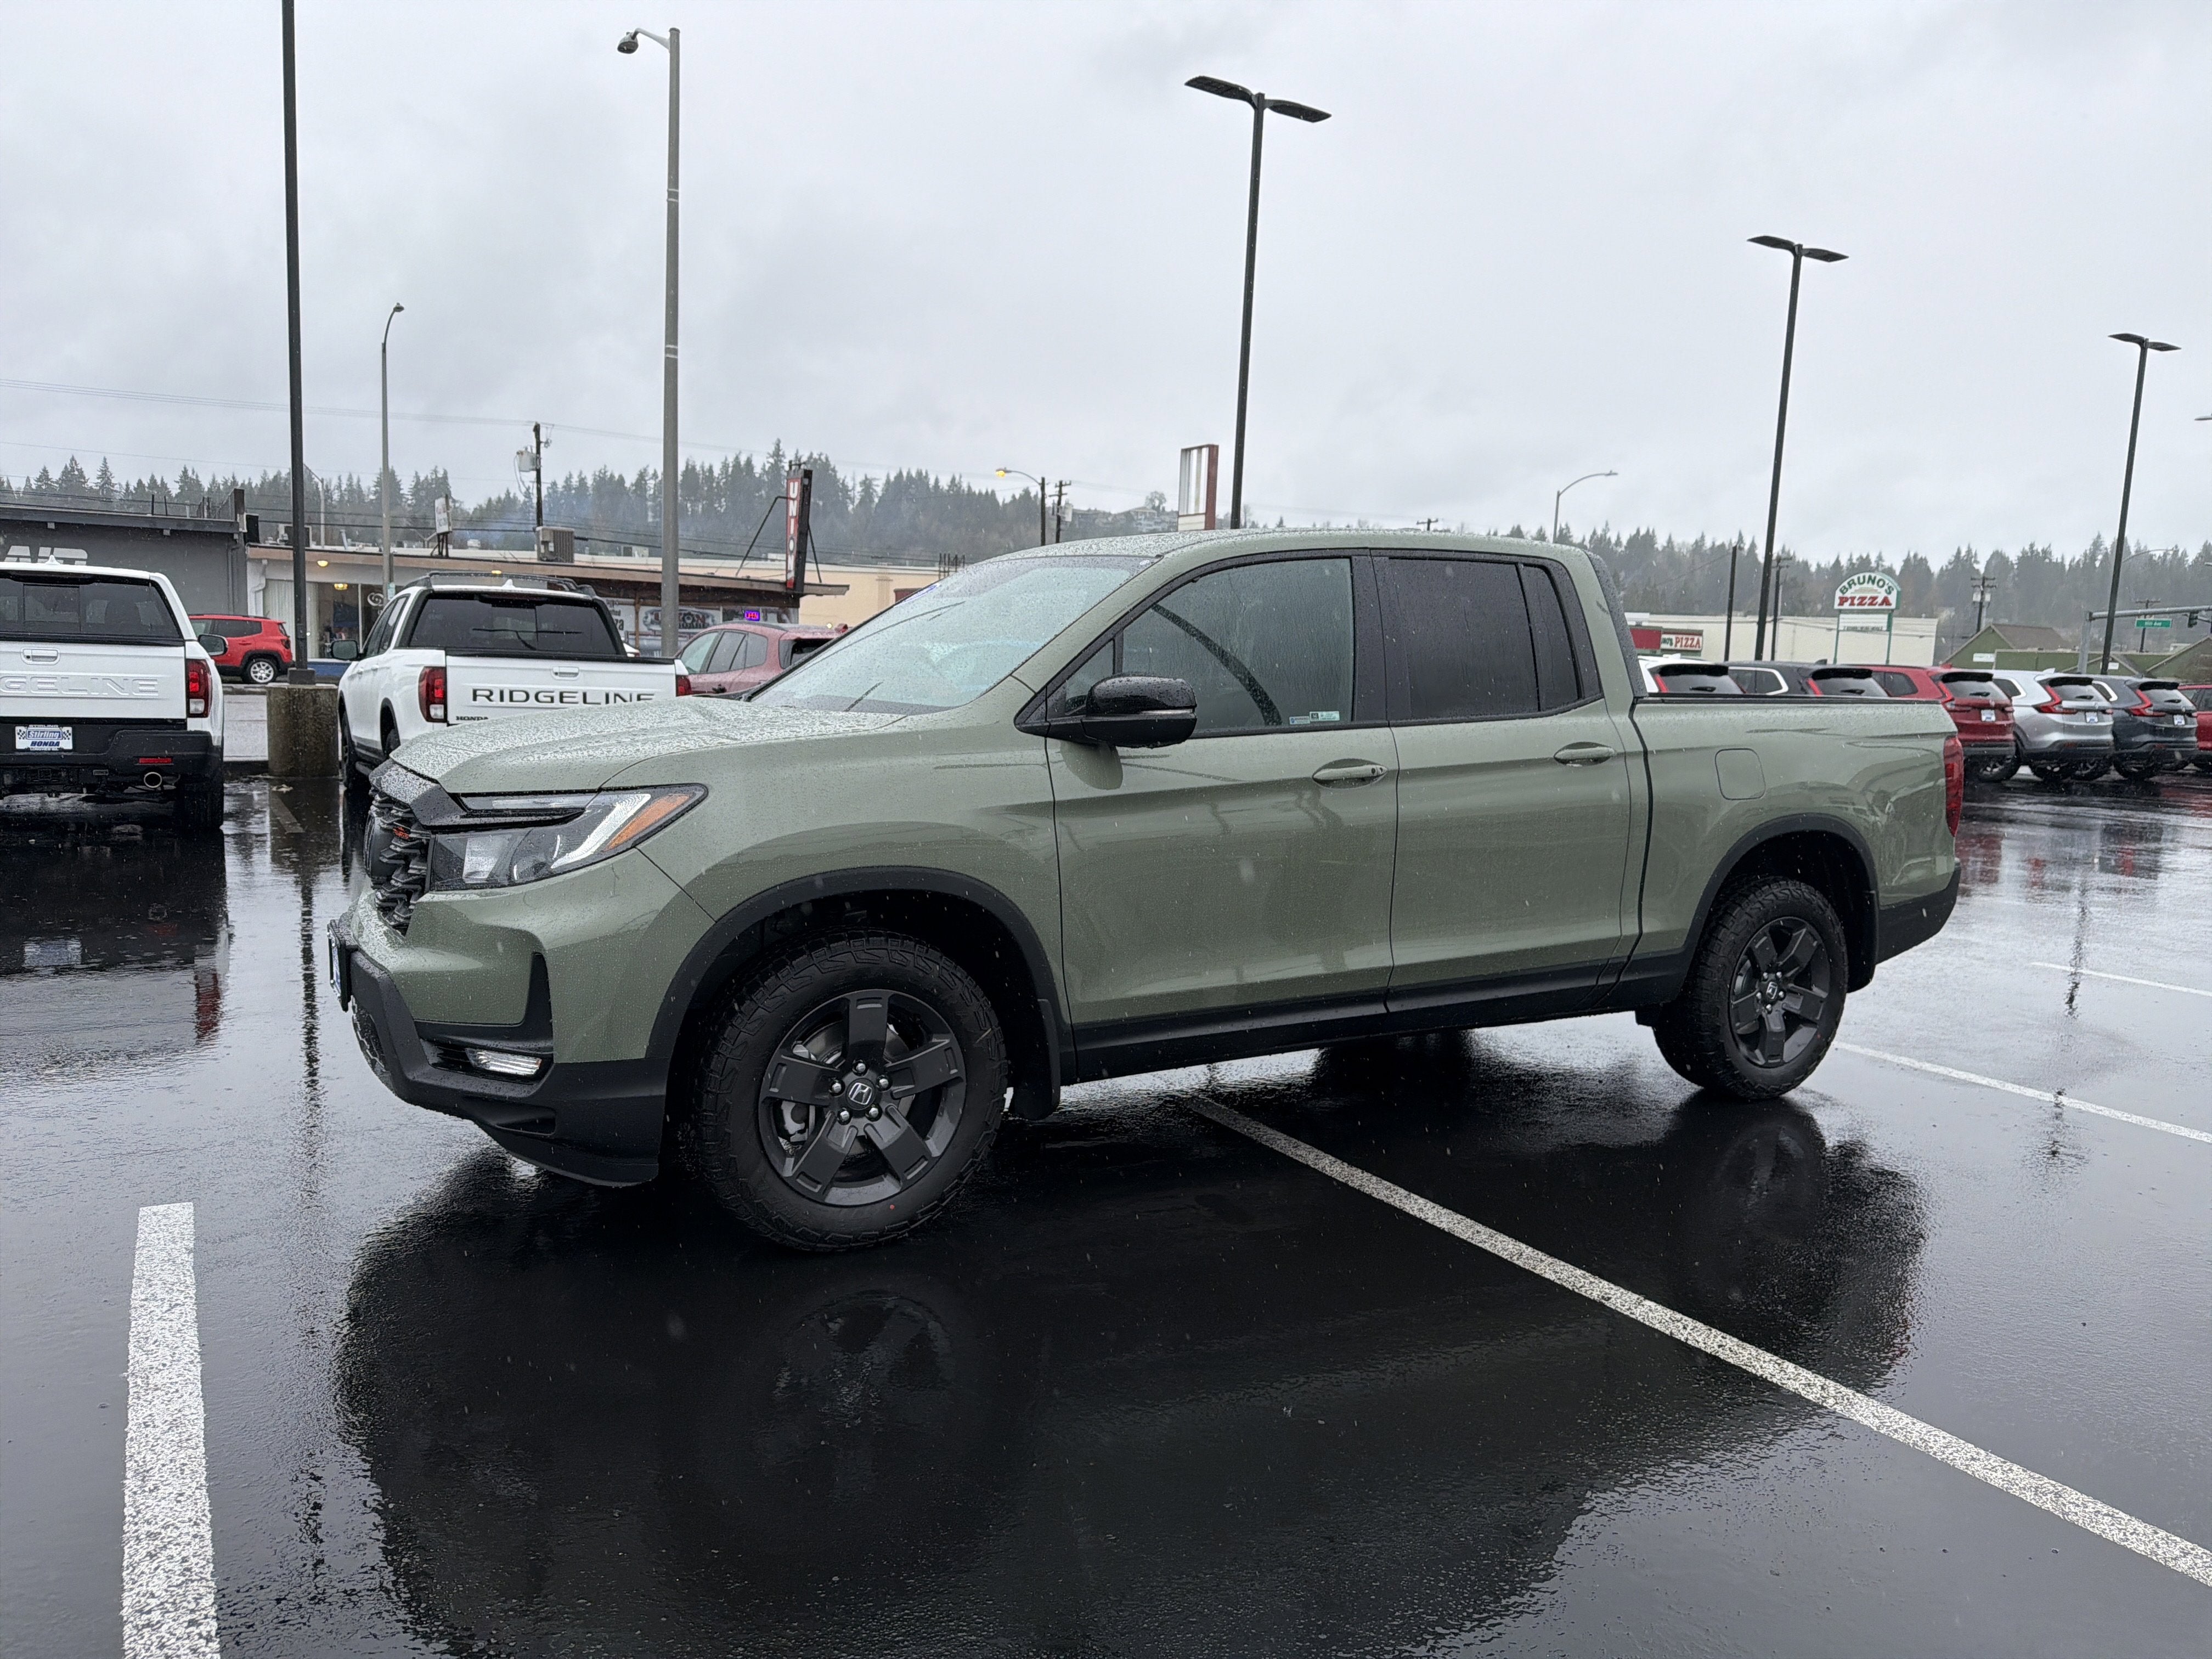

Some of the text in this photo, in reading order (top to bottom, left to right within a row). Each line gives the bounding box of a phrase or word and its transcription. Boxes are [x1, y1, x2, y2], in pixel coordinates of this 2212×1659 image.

[1839, 574, 1894, 595] BRUNO'S
[1837, 596, 1892, 606] PIZZA
[1674, 636, 1701, 648] PIZZA
[472, 688, 655, 705] RIDGELINE
[29, 731, 60, 739] Stirling
